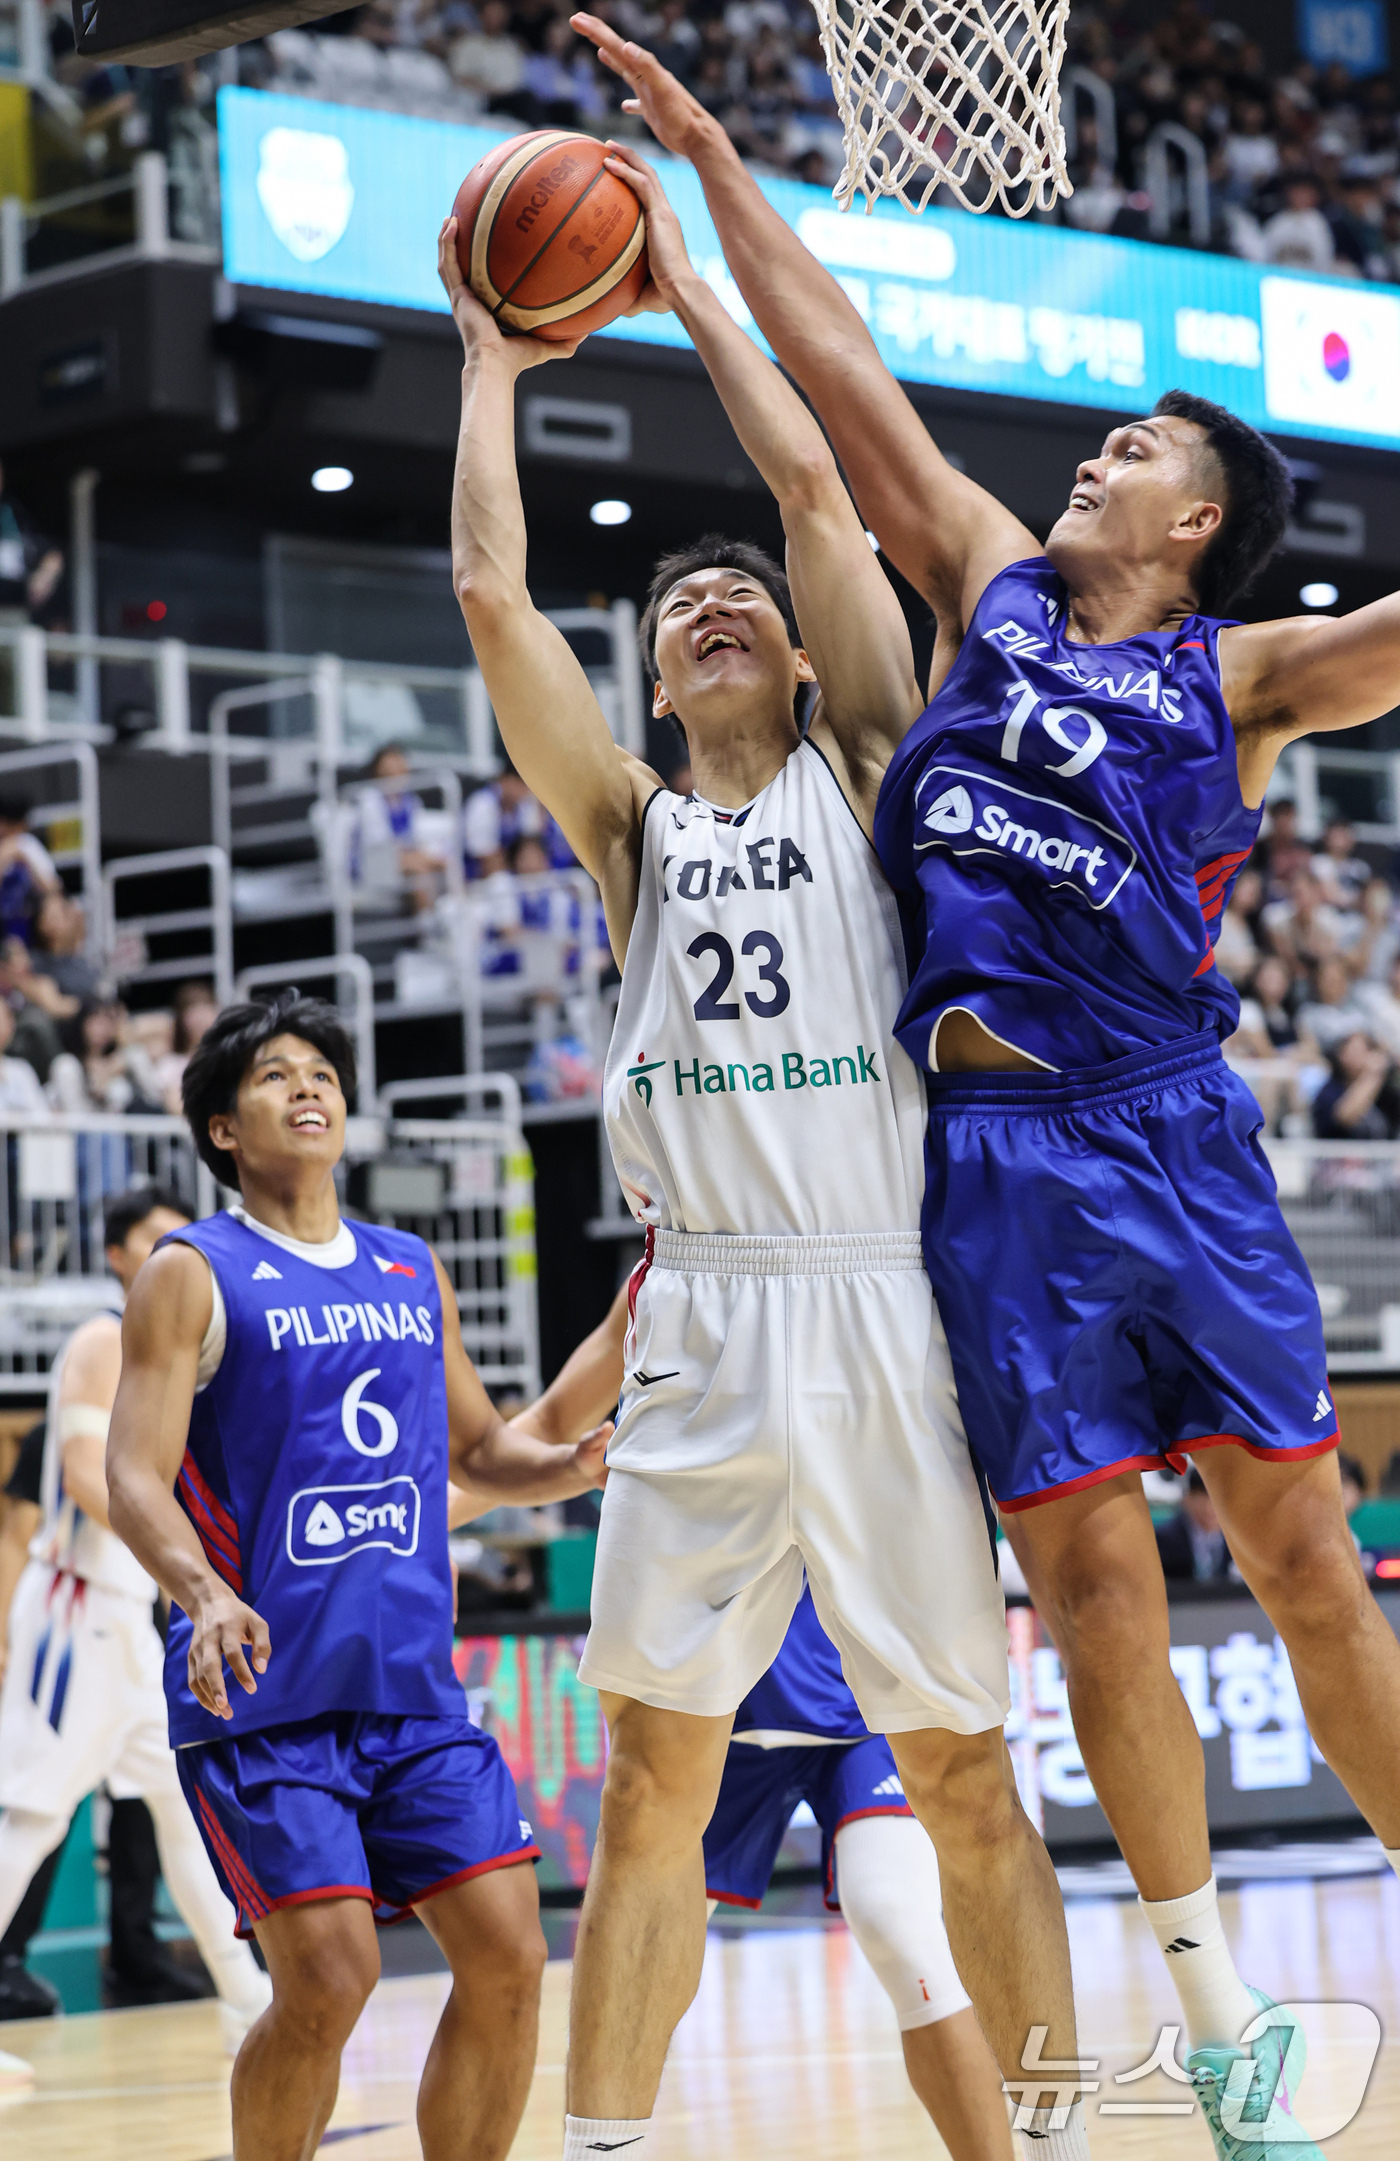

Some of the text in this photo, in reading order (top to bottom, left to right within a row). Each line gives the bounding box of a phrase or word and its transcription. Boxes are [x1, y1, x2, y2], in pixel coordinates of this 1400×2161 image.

[515, 156, 579, 233] molten
[982, 620, 1184, 723] PILPINAS
[1001, 679, 1108, 777] 19
[974, 804, 1108, 886] Smart
[686, 930, 790, 1021] 23
[674, 1045, 881, 1096] Hana Bank
[265, 1302, 435, 1350] PILIPINAS
[341, 1367, 399, 1457] 6
